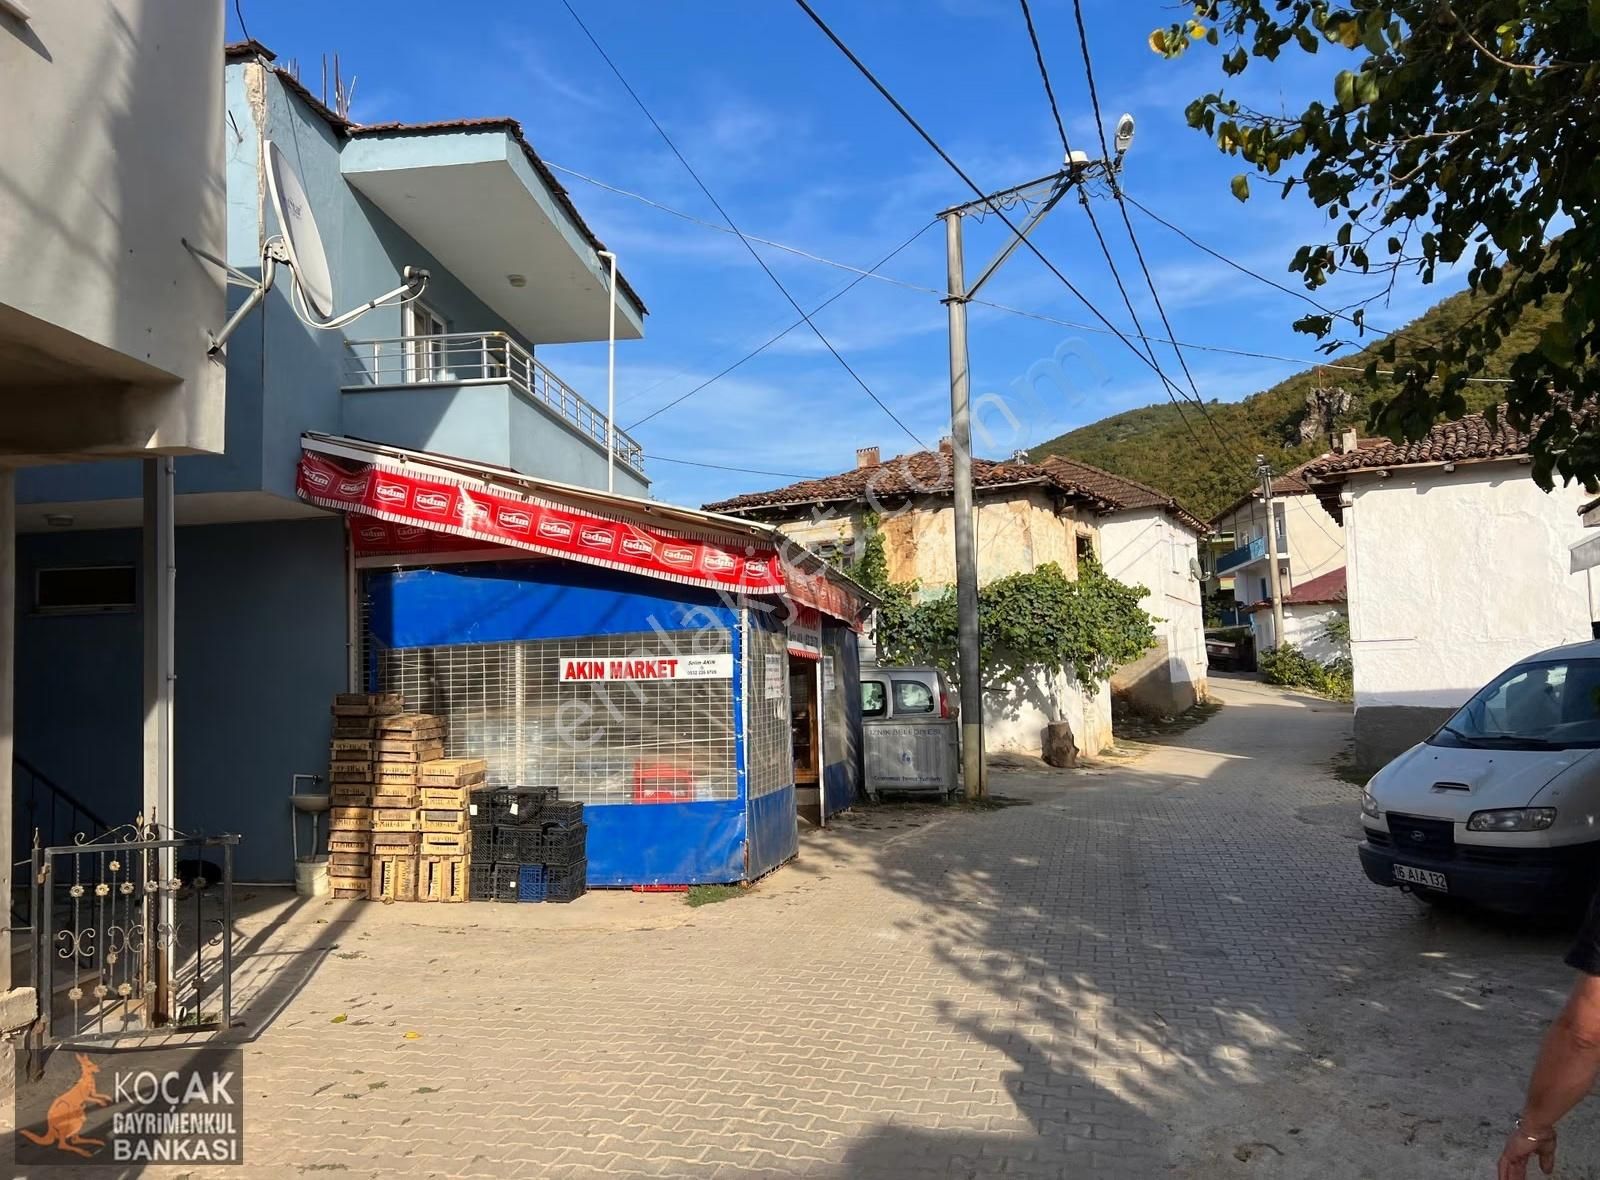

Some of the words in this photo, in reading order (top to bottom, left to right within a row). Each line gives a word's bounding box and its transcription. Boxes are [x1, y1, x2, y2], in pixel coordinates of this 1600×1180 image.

[376, 485, 406, 500] tadım
[415, 493, 447, 508] tadım
[499, 511, 529, 527] tadım
[540, 521, 570, 536] tadım
[581, 530, 612, 544] tadım
[623, 538, 653, 553] tadım
[664, 549, 693, 562] tadım
[565, 662, 604, 680] AKIN
[610, 660, 678, 679] MARKET
[1395, 865, 1405, 879] 16
[1429, 873, 1446, 887] 132
